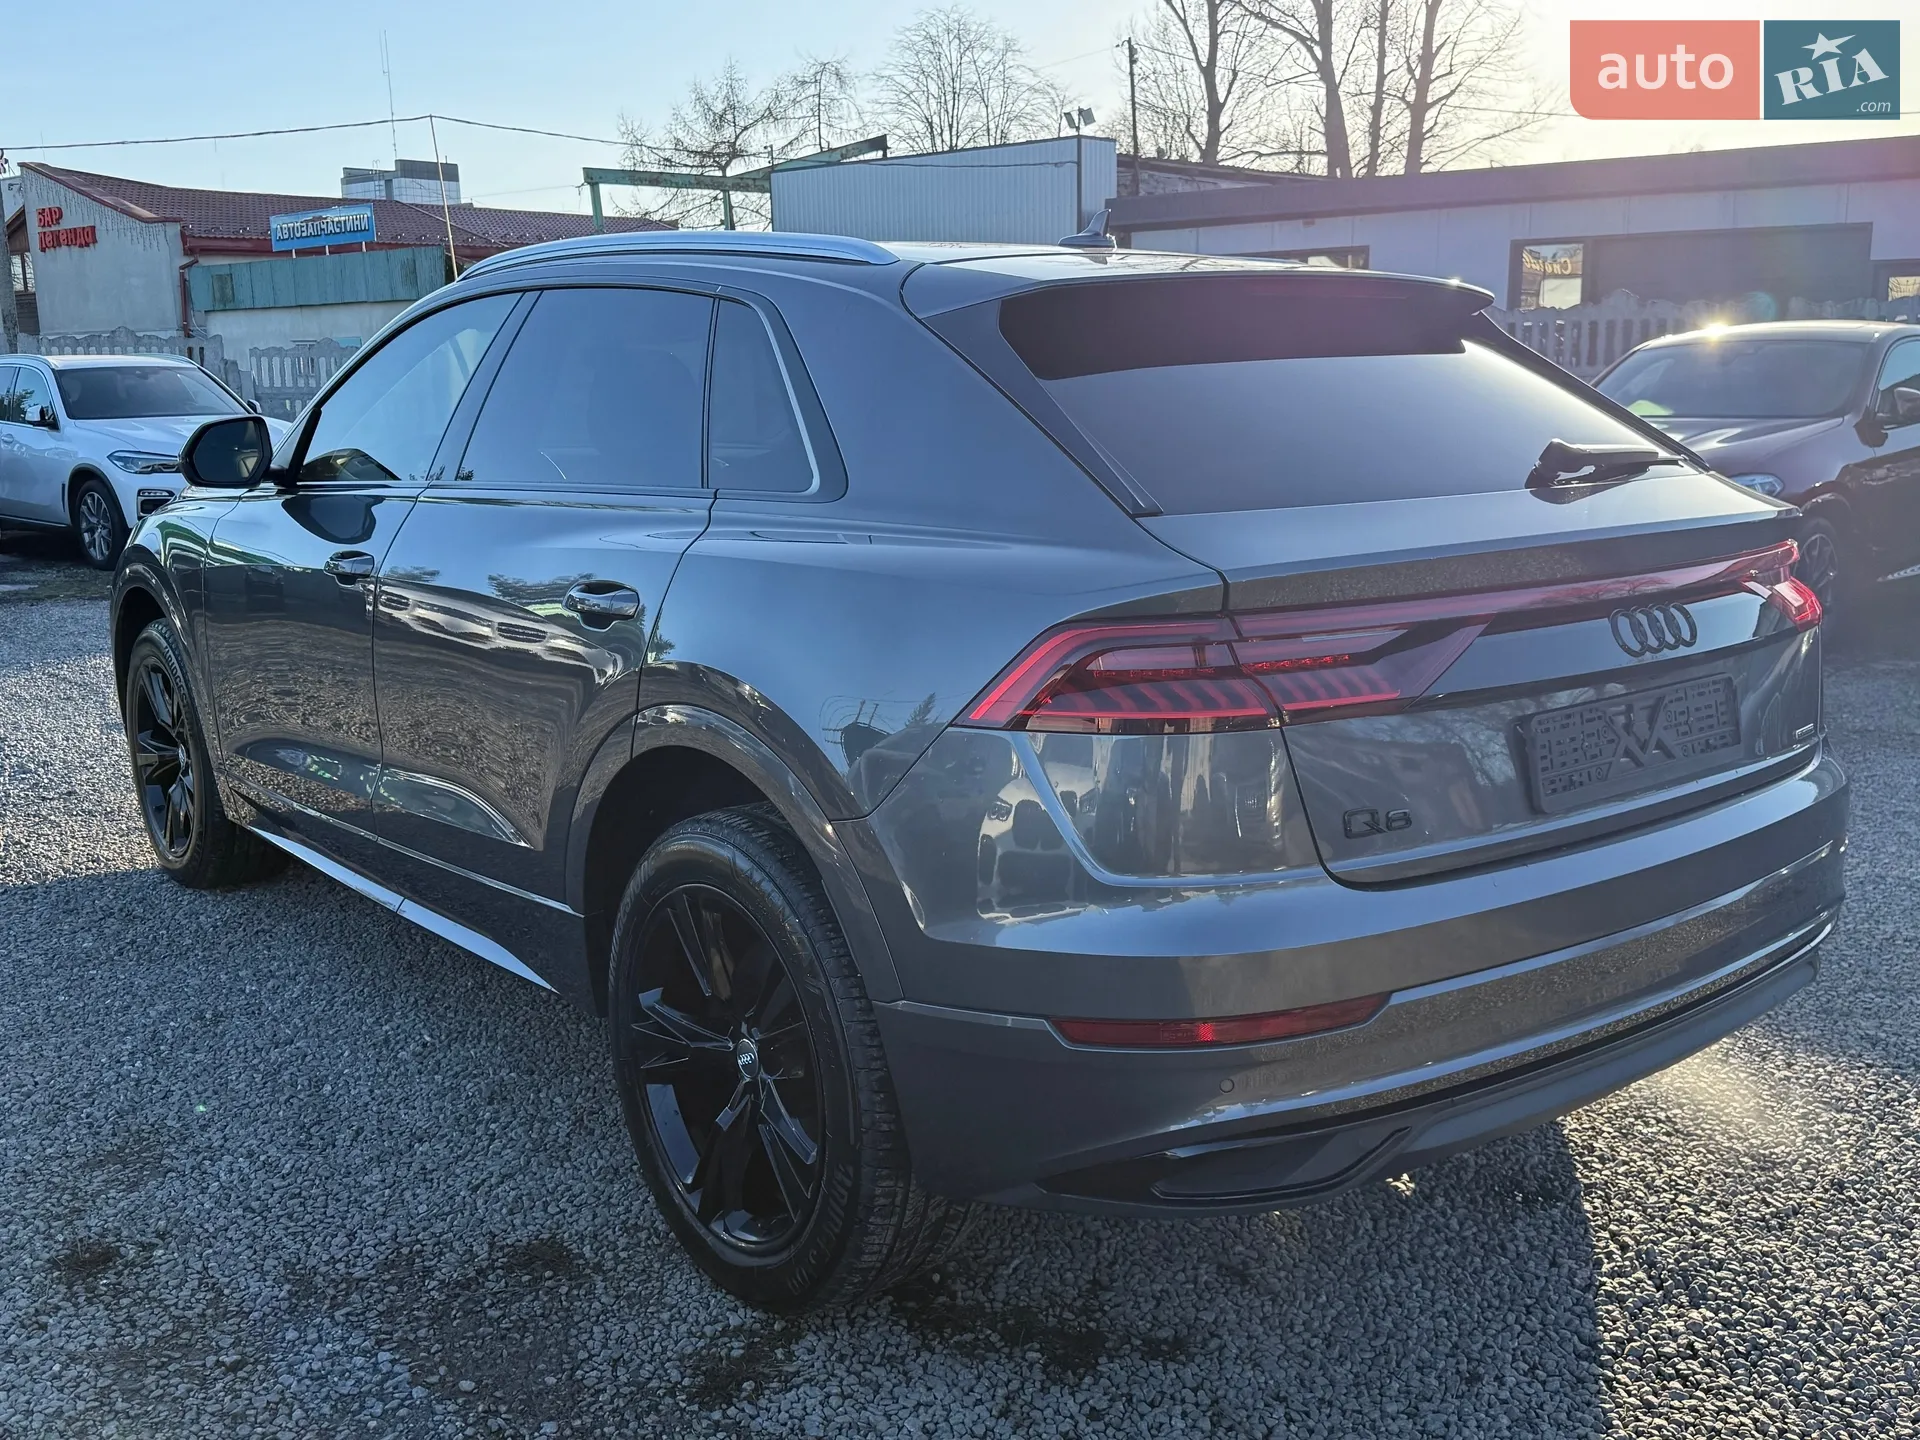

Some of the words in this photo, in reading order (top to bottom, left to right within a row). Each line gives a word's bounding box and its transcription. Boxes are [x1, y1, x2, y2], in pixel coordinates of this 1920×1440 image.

[36, 206, 63, 227] БАР
[275, 213, 370, 241] АВТОЗАПЧАСТИНИ
[1342, 807, 1413, 840] Q8
